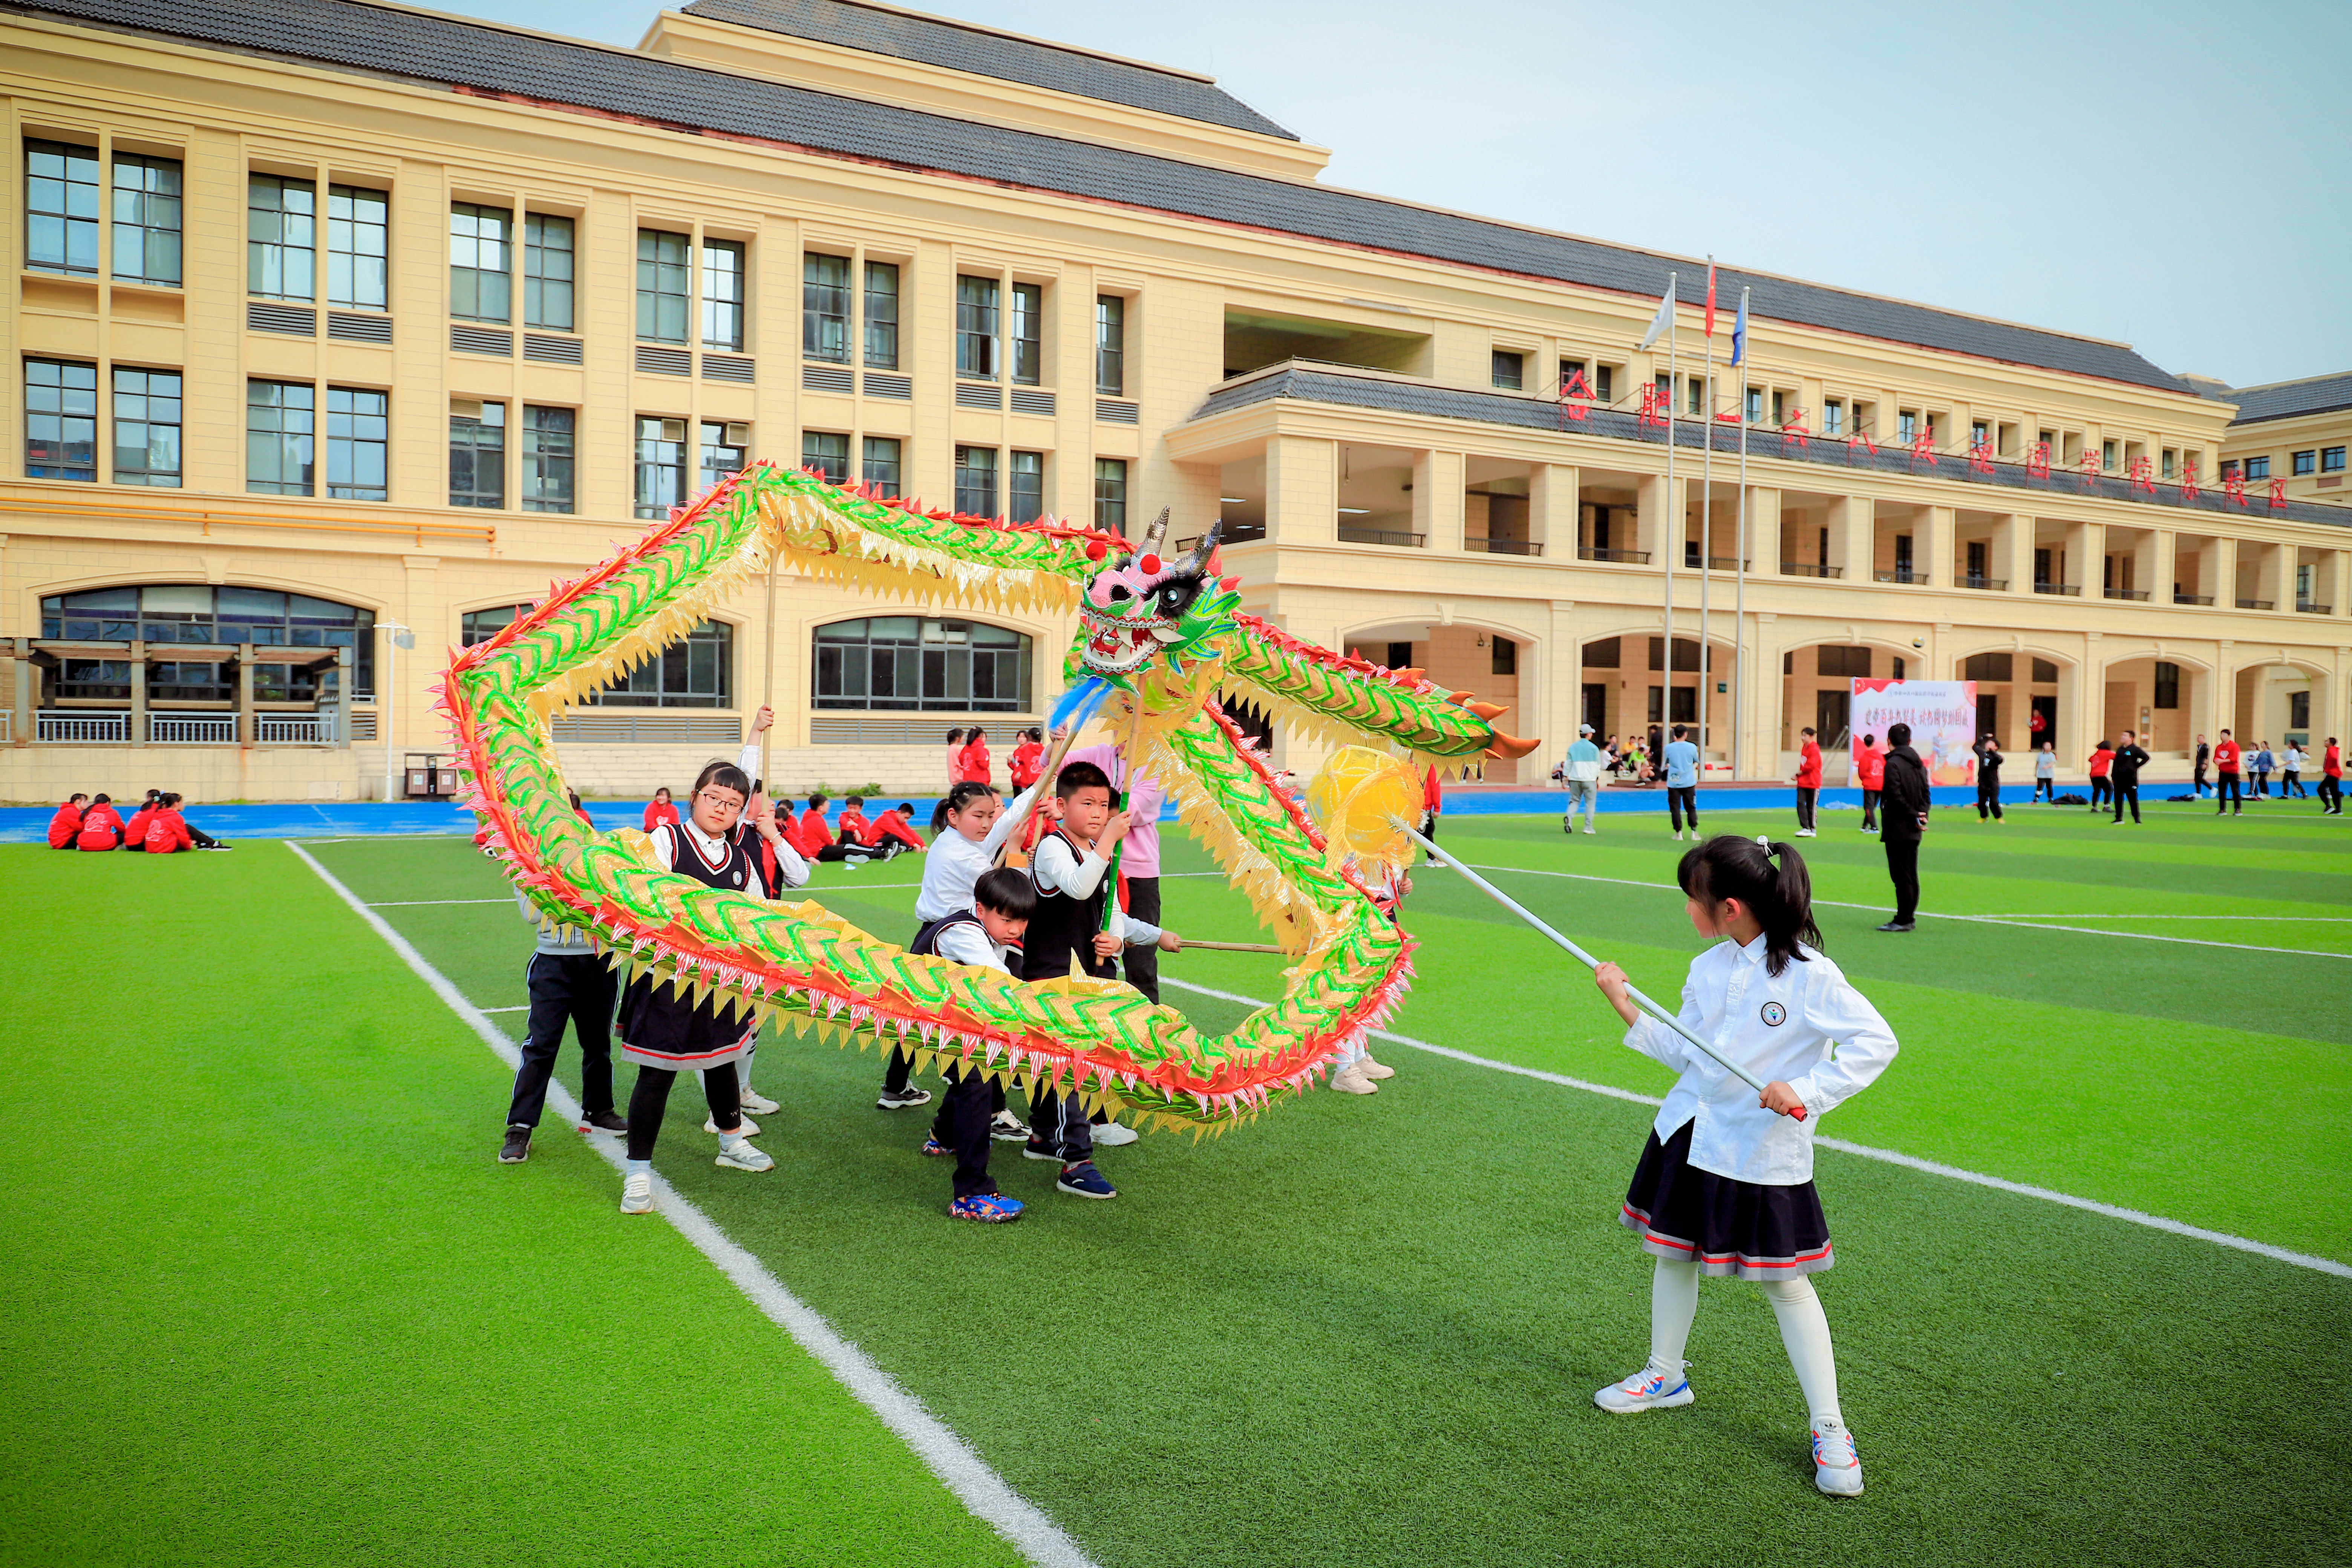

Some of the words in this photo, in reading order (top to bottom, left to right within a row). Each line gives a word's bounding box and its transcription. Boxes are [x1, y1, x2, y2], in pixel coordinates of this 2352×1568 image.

[1560, 369, 2288, 508] 合肥一六八玫瑰园学校东校区
